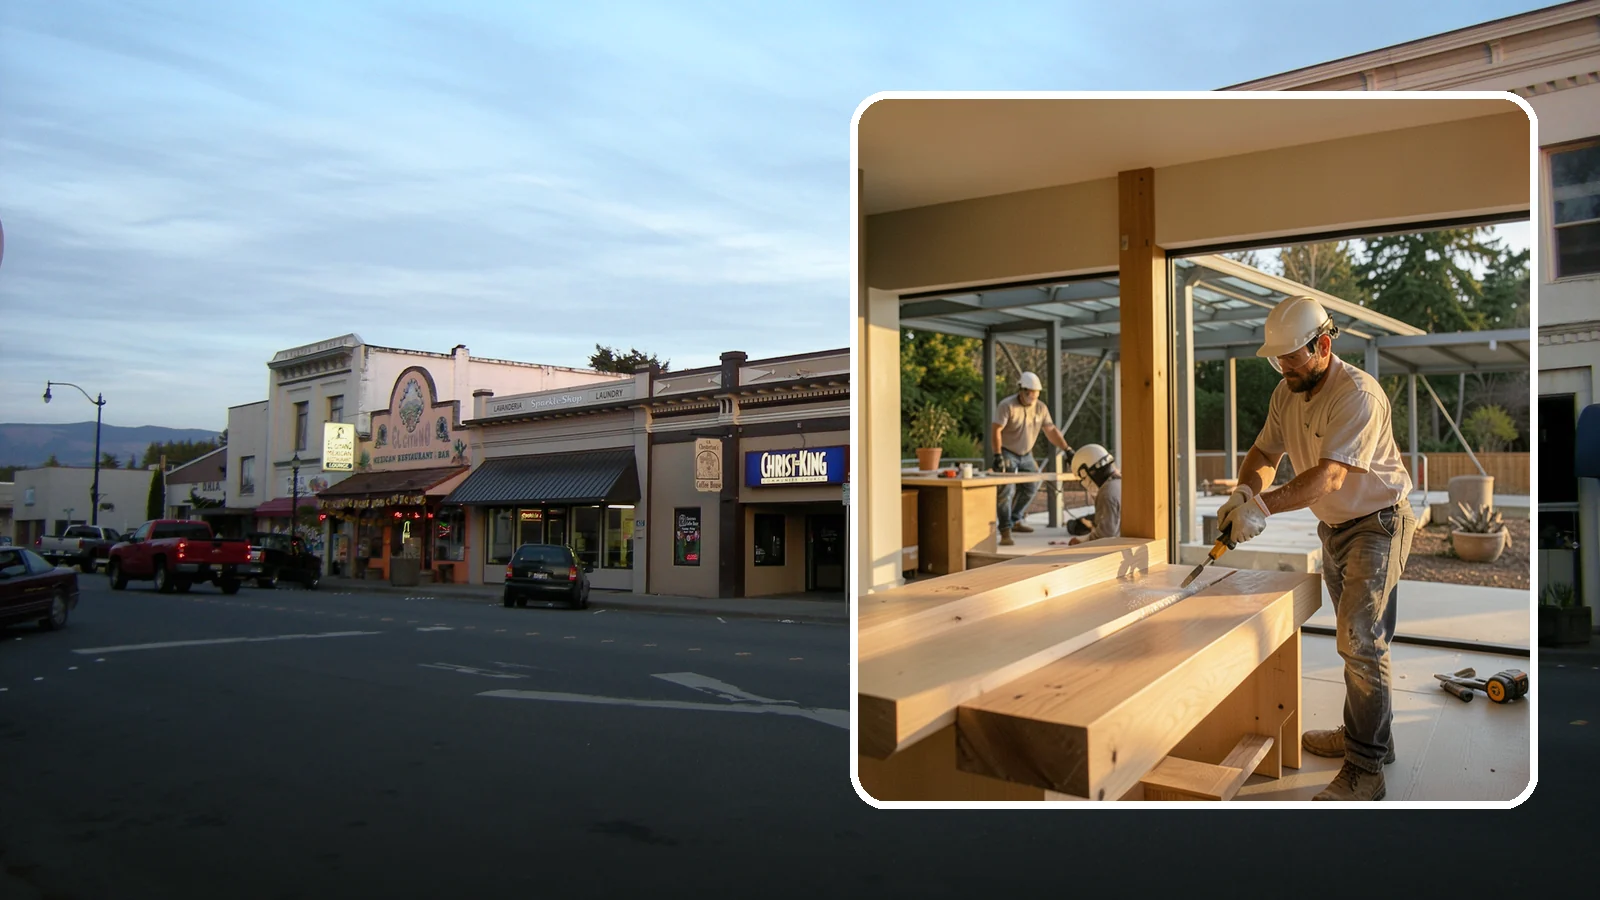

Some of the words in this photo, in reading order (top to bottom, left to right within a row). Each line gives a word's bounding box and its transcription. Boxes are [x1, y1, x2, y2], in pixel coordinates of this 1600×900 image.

[596, 389, 624, 399] LAUNDRY
[493, 402, 523, 412] LAVANDERIA
[374, 455, 396, 464] MEXICAN
[398, 451, 433, 462] RESTAURANT
[438, 450, 450, 459] BAR
[761, 452, 798, 478] CHRIST
[799, 450, 828, 476] KING
[710, 481, 722, 489] House
